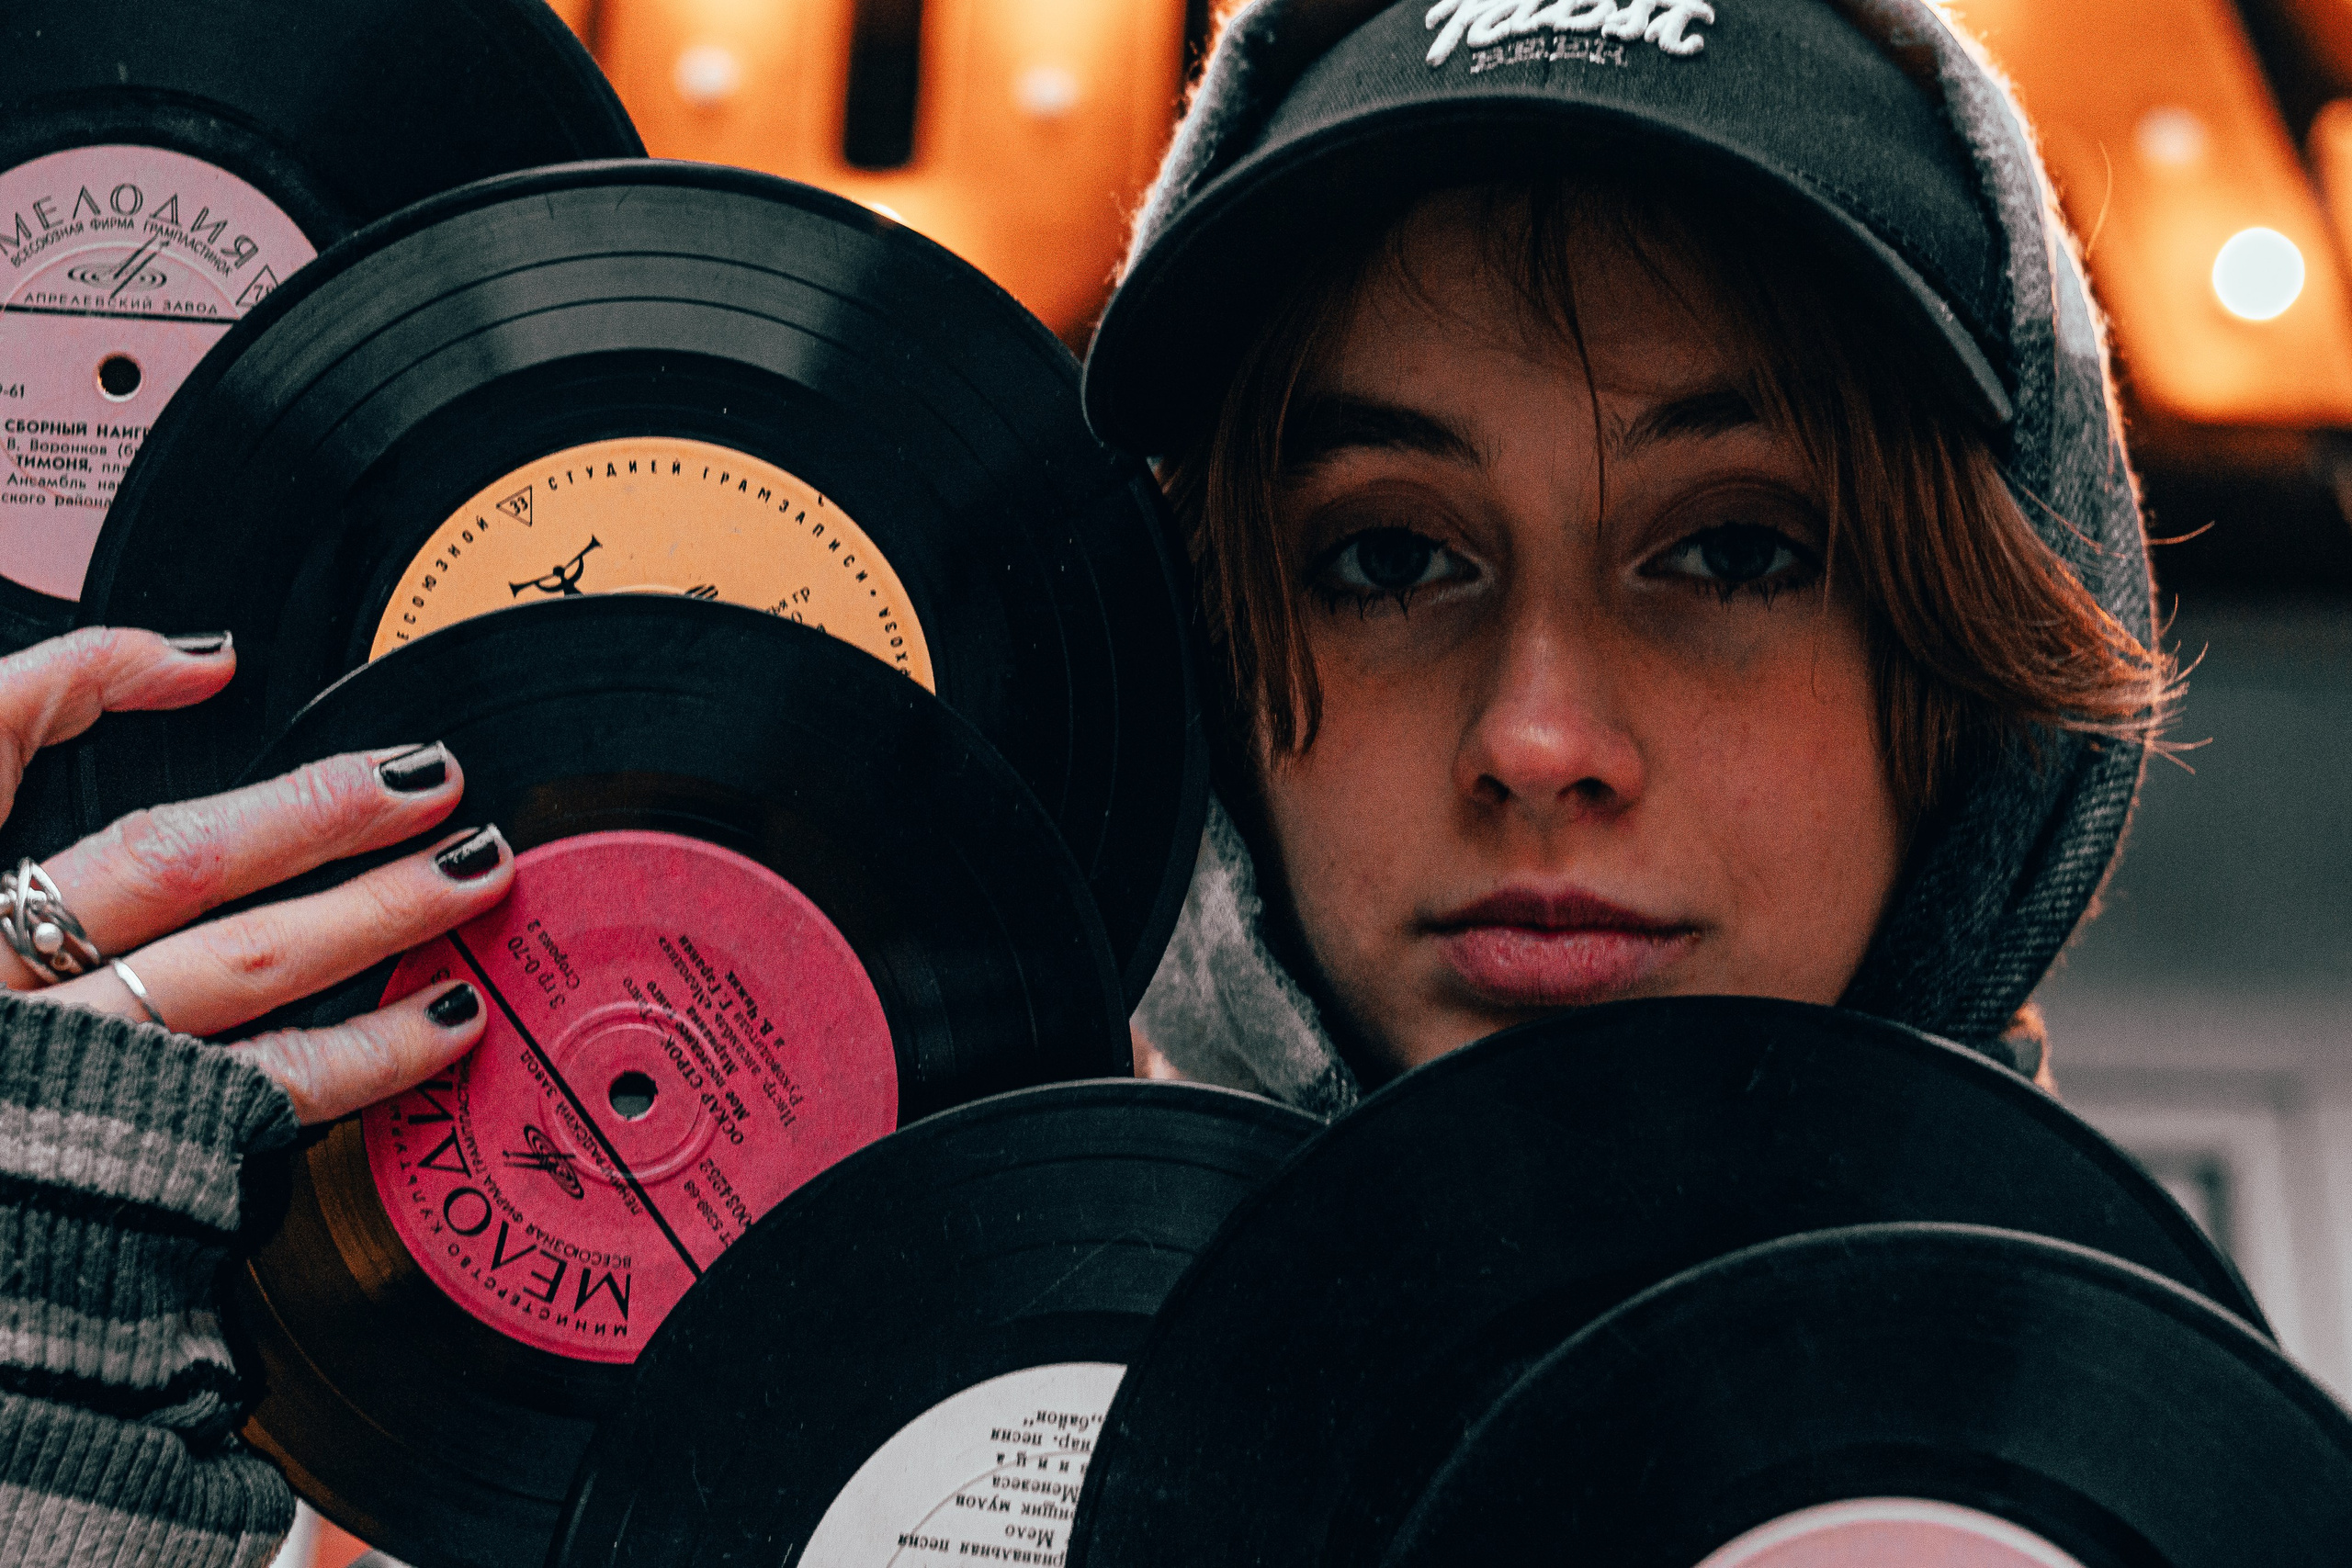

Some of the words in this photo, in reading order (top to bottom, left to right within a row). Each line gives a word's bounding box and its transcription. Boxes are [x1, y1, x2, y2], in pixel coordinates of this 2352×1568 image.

[0, 184, 259, 268] МЕЛОДИЯ
[11, 221, 85, 268] ВСЕСОЮЗНАЯ
[90, 218, 135, 231] ФИРМА
[143, 220, 232, 278] ГРАМПЛАСТИНОК
[24, 291, 153, 310] АПРЕЛЕВСКИЙ
[163, 300, 218, 314] ЗАВОД
[5, 418, 88, 436] СБОРНЫЙ
[29, 438, 107, 456] Воронков
[6, 472, 87, 490] Ансамбль
[97, 479, 120, 491] на
[16, 454, 92, 474] ТИМОНЯ,
[509, 497, 529, 516] 33
[548, 458, 681, 491] СТУДИЕЙ
[703, 467, 868, 583] ГРАМЗАПИСИ
[392, 514, 489, 649] ЕСОЮЗНОЙ
[507, 936, 540, 975] 0-70
[539, 931, 581, 987] Сторона
[659, 936, 713, 1010] «Мелодия»
[678, 935, 722, 995] Гаранян
[548, 993, 566, 1010] 3
[623, 977, 653, 1022] Танго
[646, 981, 676, 1021] танго
[725, 970, 758, 1021] Чижик
[660, 1034, 704, 1089] СТРОК
[673, 1021, 726, 1089] последнее
[686, 1006, 739, 1076] Марианна
[714, 1012, 762, 1076] ансамбль
[519, 1049, 559, 1100] ЗАВОД
[701, 1093, 745, 1146] ОСКАР
[724, 1090, 751, 1122] Мое
[389, 1105, 444, 1234] КУЛЬТУРЫ
[555, 1101, 643, 1216] ЛЕНИНГРАДСКИЙ
[408, 1064, 631, 1321] МЕЛОДИ
[482, 1173, 524, 1224] ФИРМА
[525, 1223, 632, 1269] ВСЕСОЮЗНАЯ
[447, 1243, 628, 1337] МИНИСТЕРСТВО
[990, 1427, 1043, 1447] песня
[1053, 1433, 1091, 1452] нар.
[956, 1494, 1012, 1513] мулов
[992, 1474, 1080, 1504] Менезеса
[1021, 1500, 1075, 1521] нщик
[898, 1531, 950, 1552] песня
[1005, 1524, 1056, 1550] Мело
